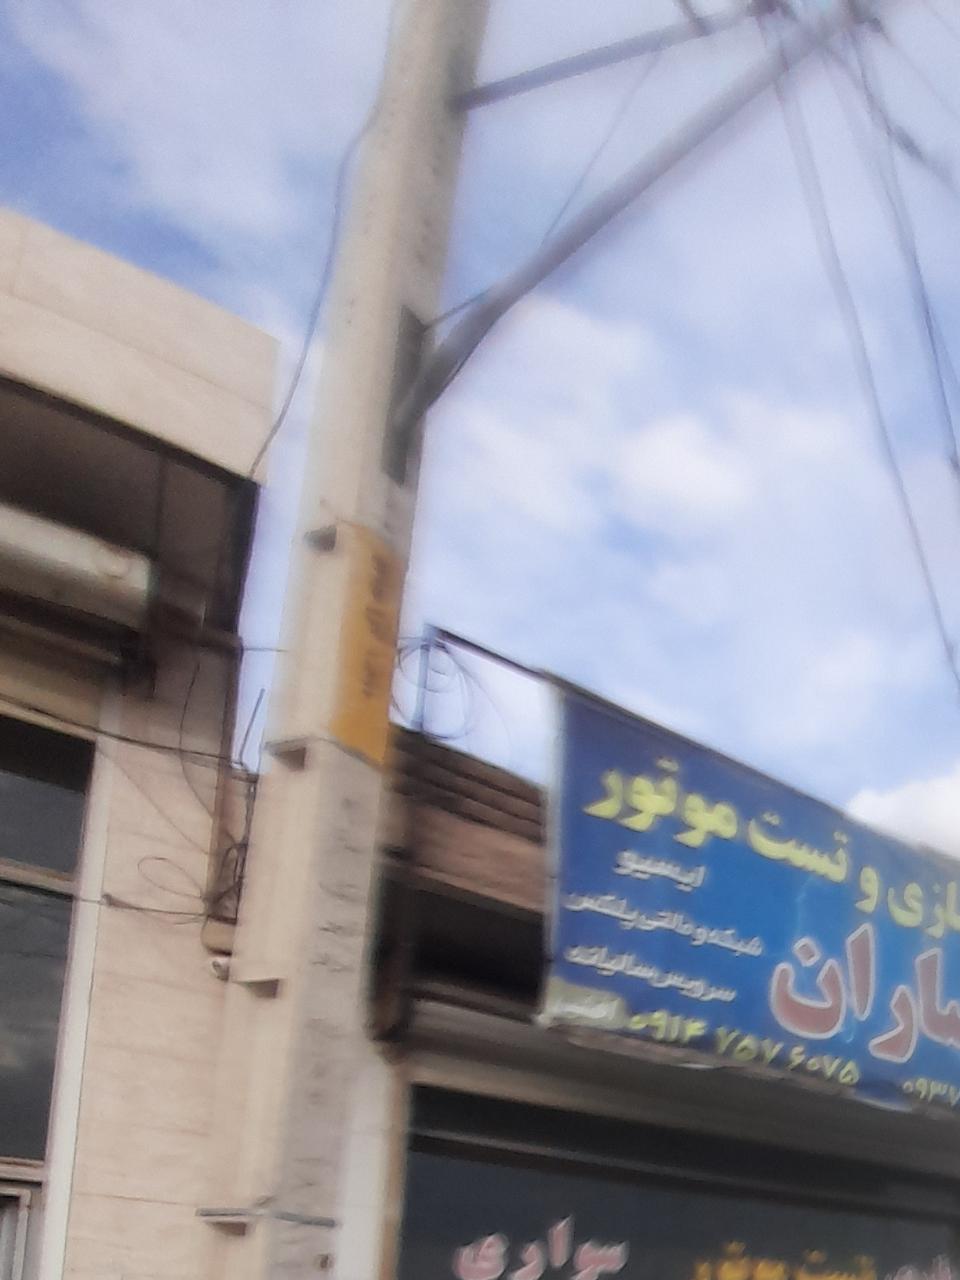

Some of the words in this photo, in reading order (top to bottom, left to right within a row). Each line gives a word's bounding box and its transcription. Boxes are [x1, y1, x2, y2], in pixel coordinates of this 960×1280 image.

[583, 757, 738, 848] موتور
[748, 810, 849, 883] تست
[855, 866, 879, 913] و
